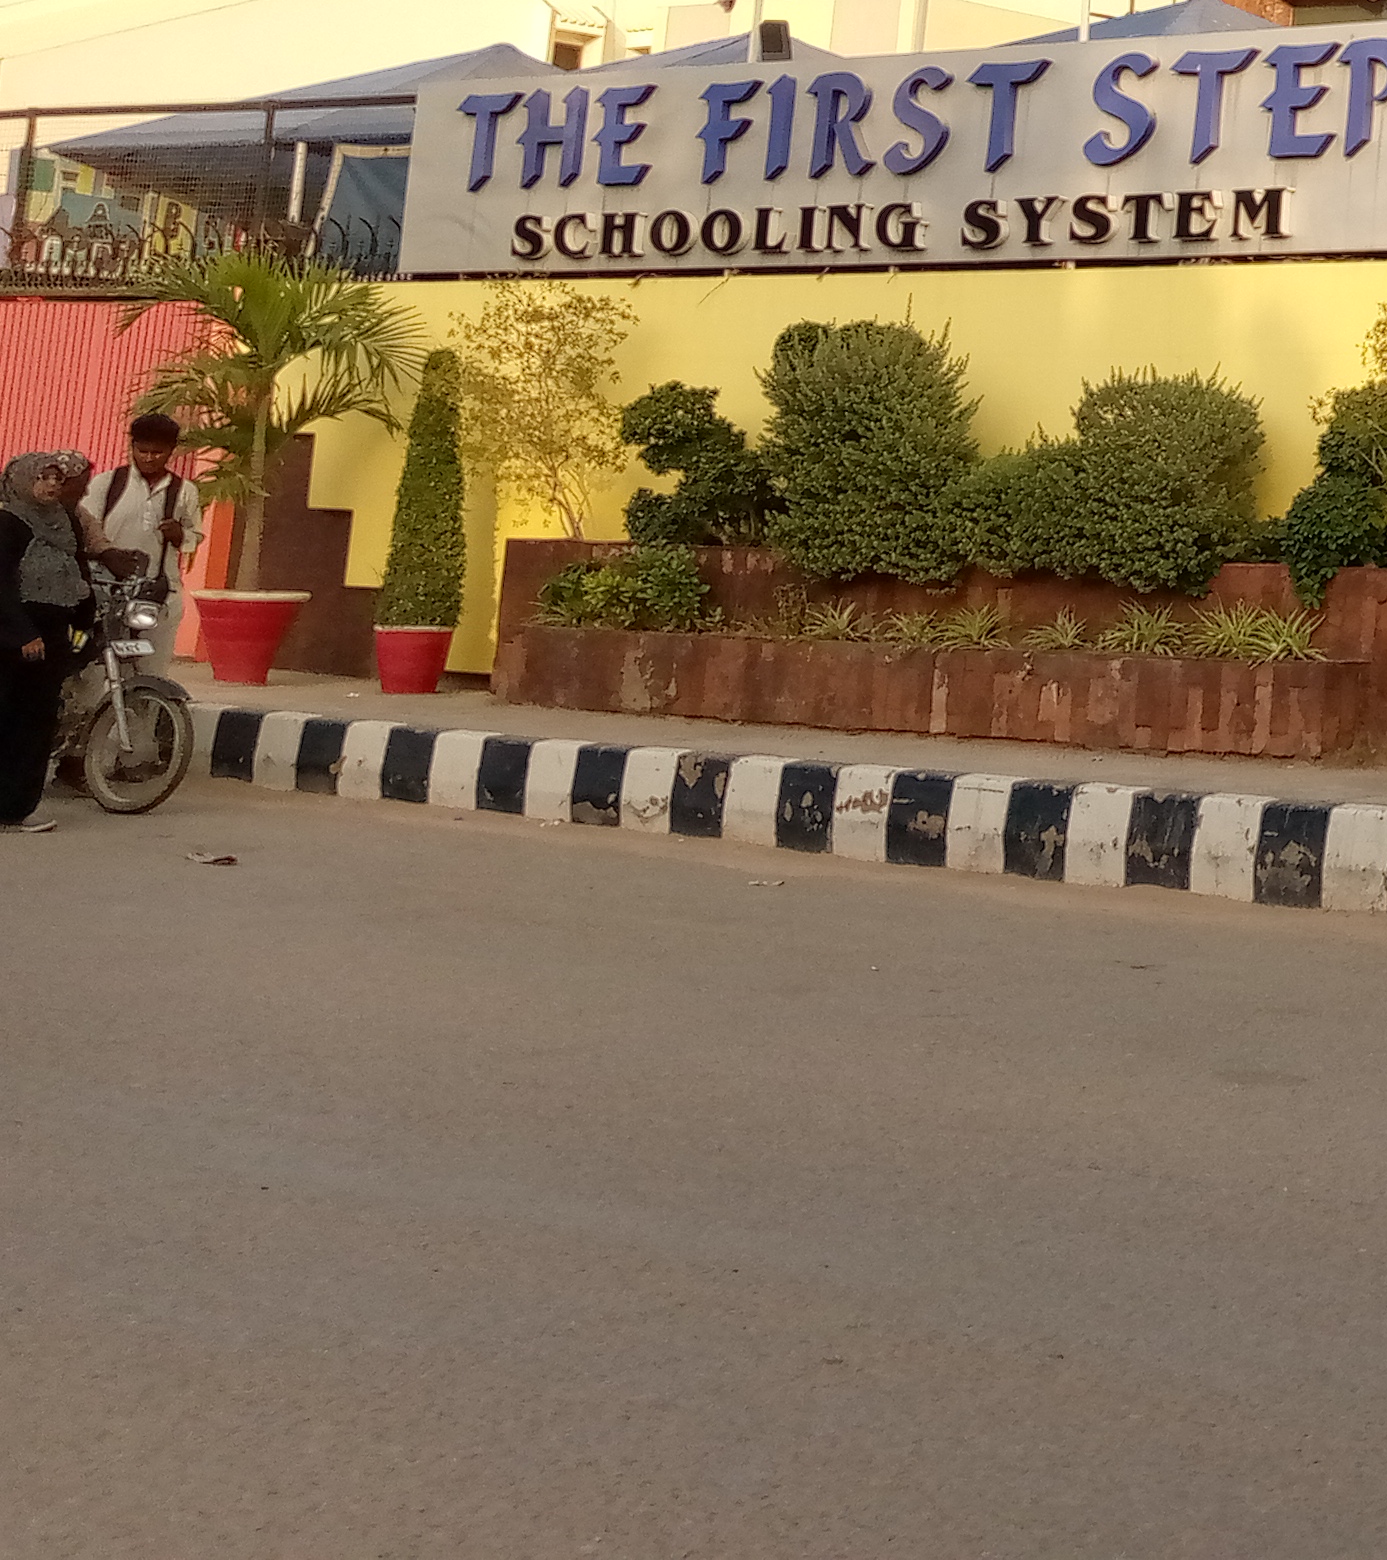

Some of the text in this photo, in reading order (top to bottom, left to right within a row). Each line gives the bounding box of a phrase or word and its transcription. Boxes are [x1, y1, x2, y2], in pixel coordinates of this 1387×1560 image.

[457, 81, 659, 192] THE
[695, 58, 1054, 185] FIRST
[511, 186, 1295, 260] SCHOOLING SYSTEM
